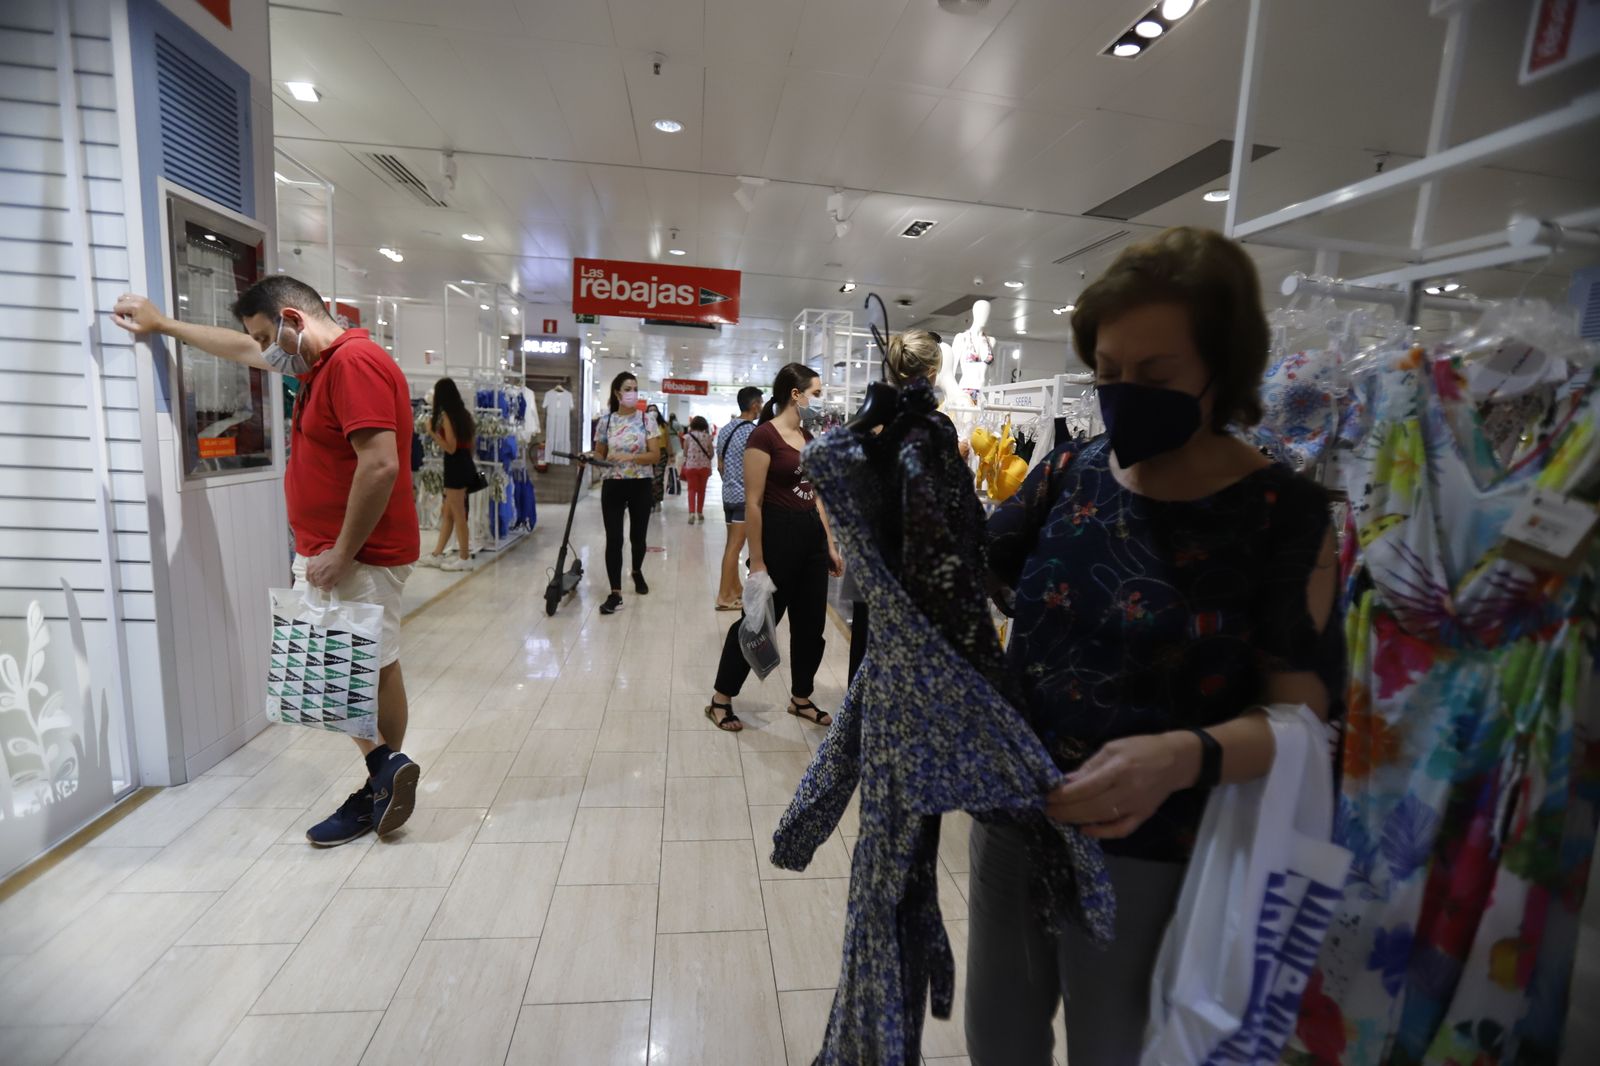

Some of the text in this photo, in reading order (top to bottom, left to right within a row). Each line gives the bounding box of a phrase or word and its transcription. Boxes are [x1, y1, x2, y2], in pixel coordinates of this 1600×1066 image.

[581, 265, 604, 278] Las
[580, 273, 694, 309] rebajas
[664, 382, 696, 392] rebajas
